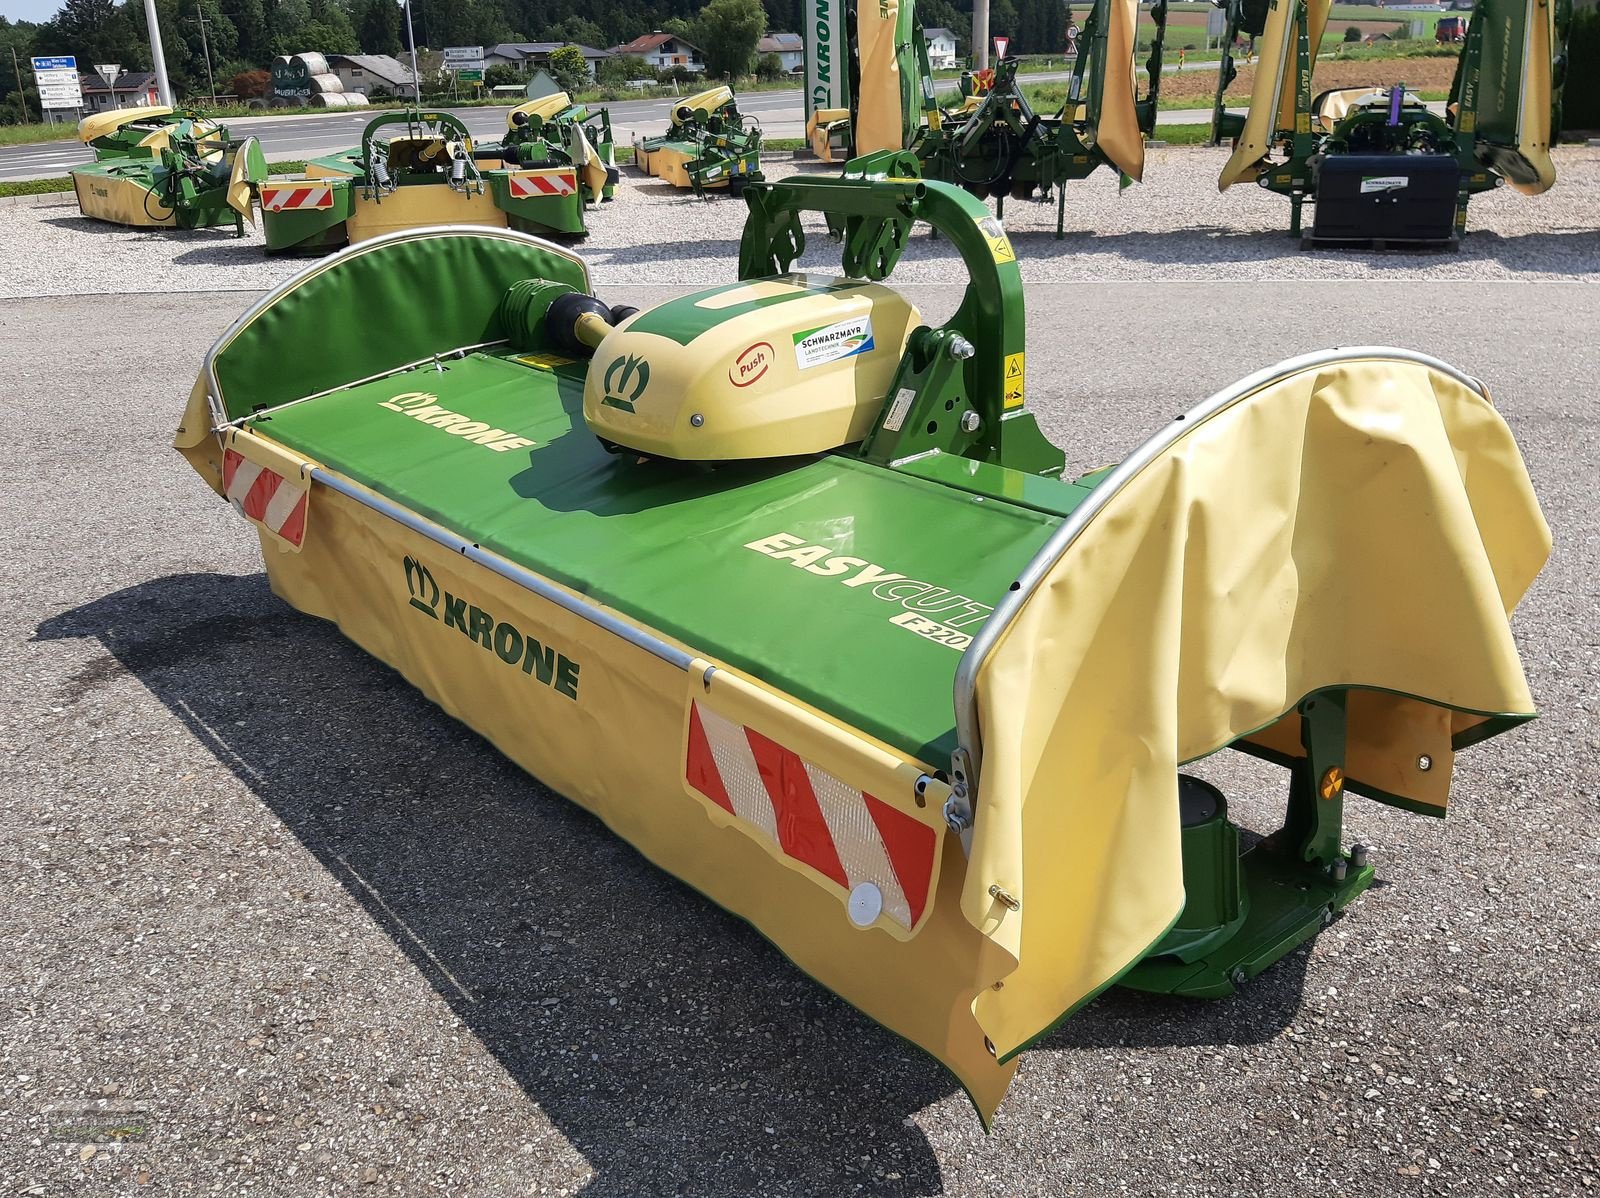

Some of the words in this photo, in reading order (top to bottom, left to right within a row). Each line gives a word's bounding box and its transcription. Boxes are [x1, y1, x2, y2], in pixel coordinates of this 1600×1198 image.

[801, 326, 861, 349] SCHWARZMAYR
[740, 352, 765, 377] Push
[403, 405, 537, 452] KRONE
[444, 591, 580, 701] KRONE
